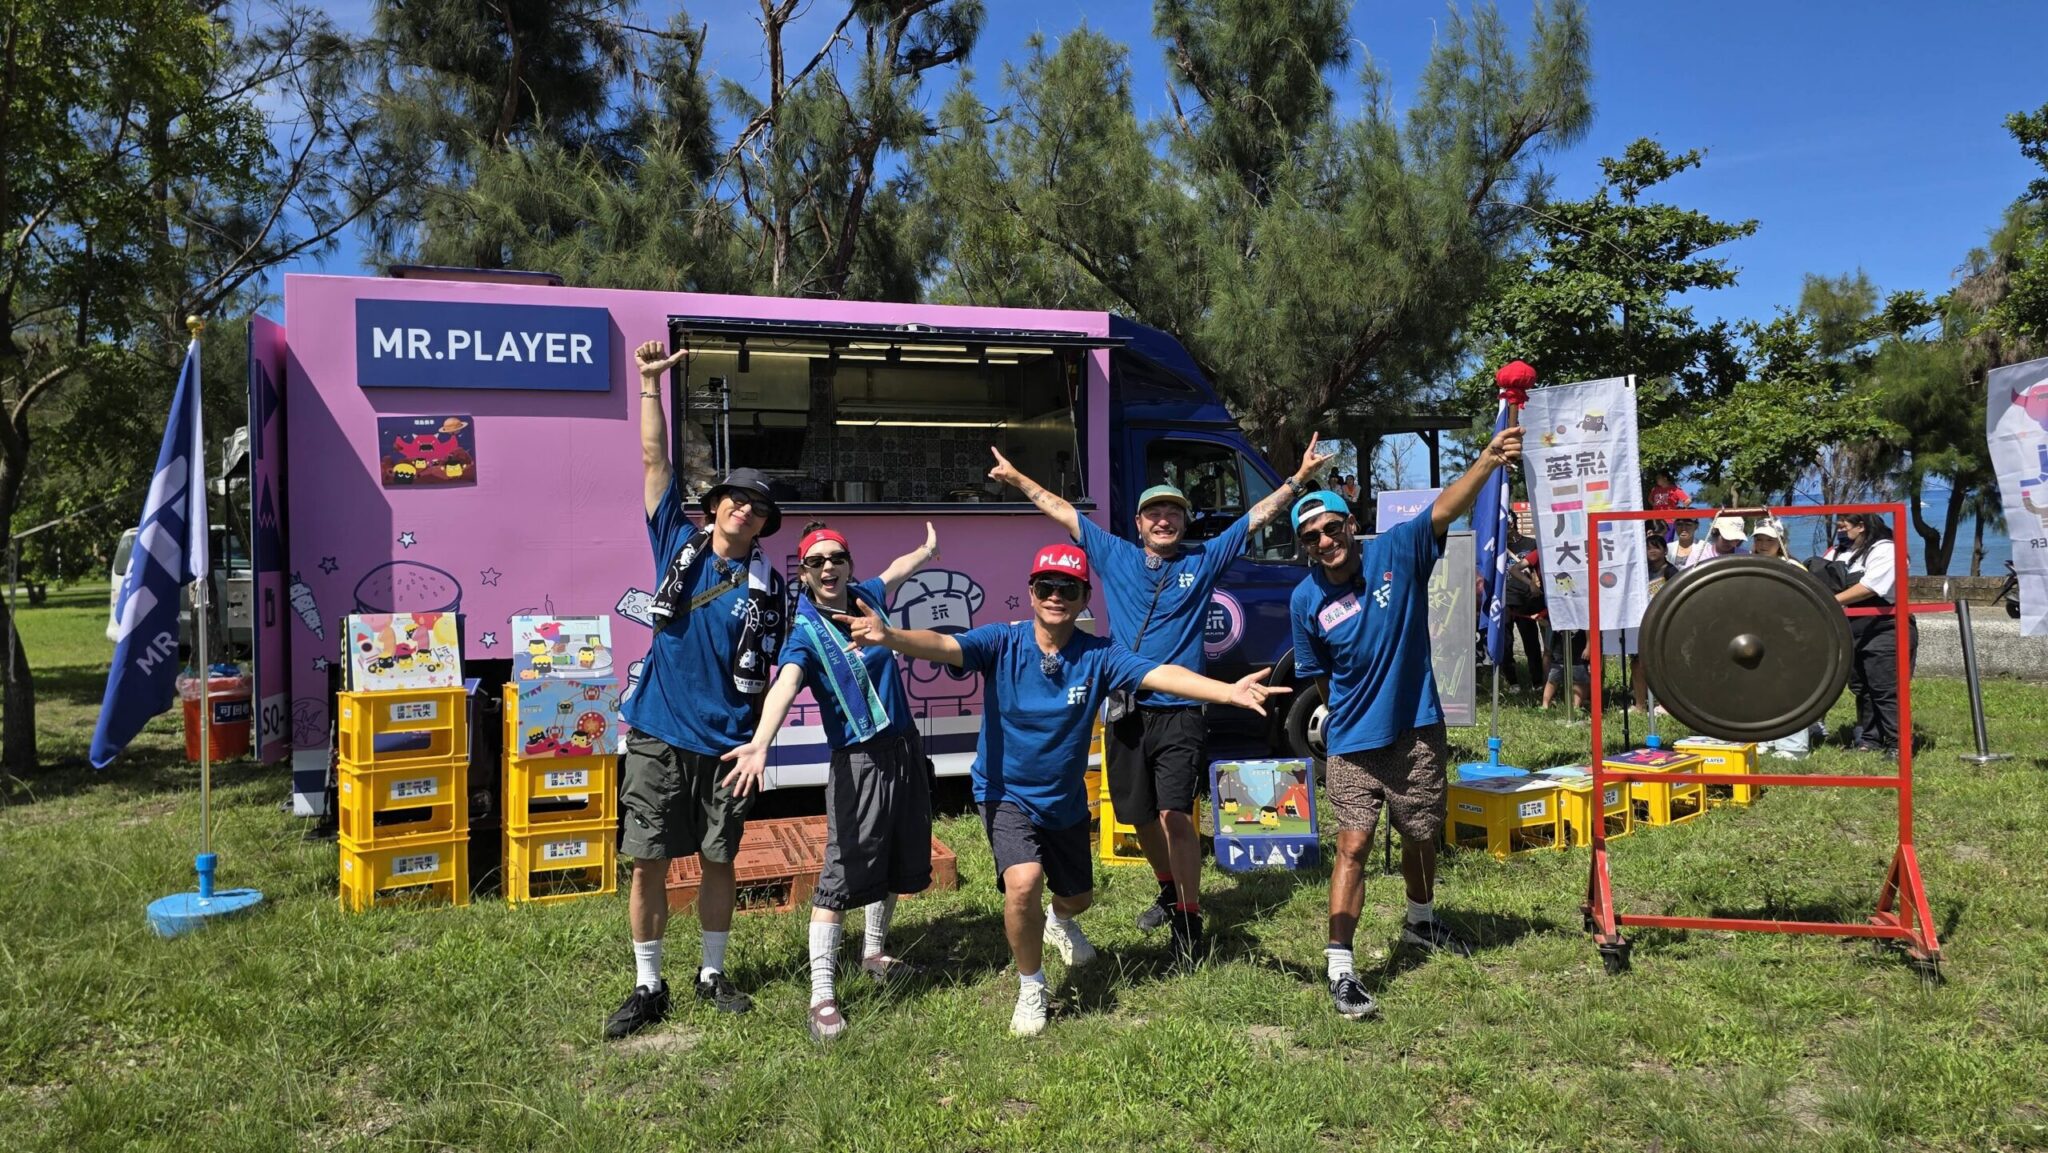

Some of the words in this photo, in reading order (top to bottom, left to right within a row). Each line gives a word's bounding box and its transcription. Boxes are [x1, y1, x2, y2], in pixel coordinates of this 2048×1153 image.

[372, 327, 594, 364] MR.PLAYER
[930, 603, 950, 621] 玩
[1067, 685, 1088, 705] 玩
[1229, 844, 1304, 865] PLAY
